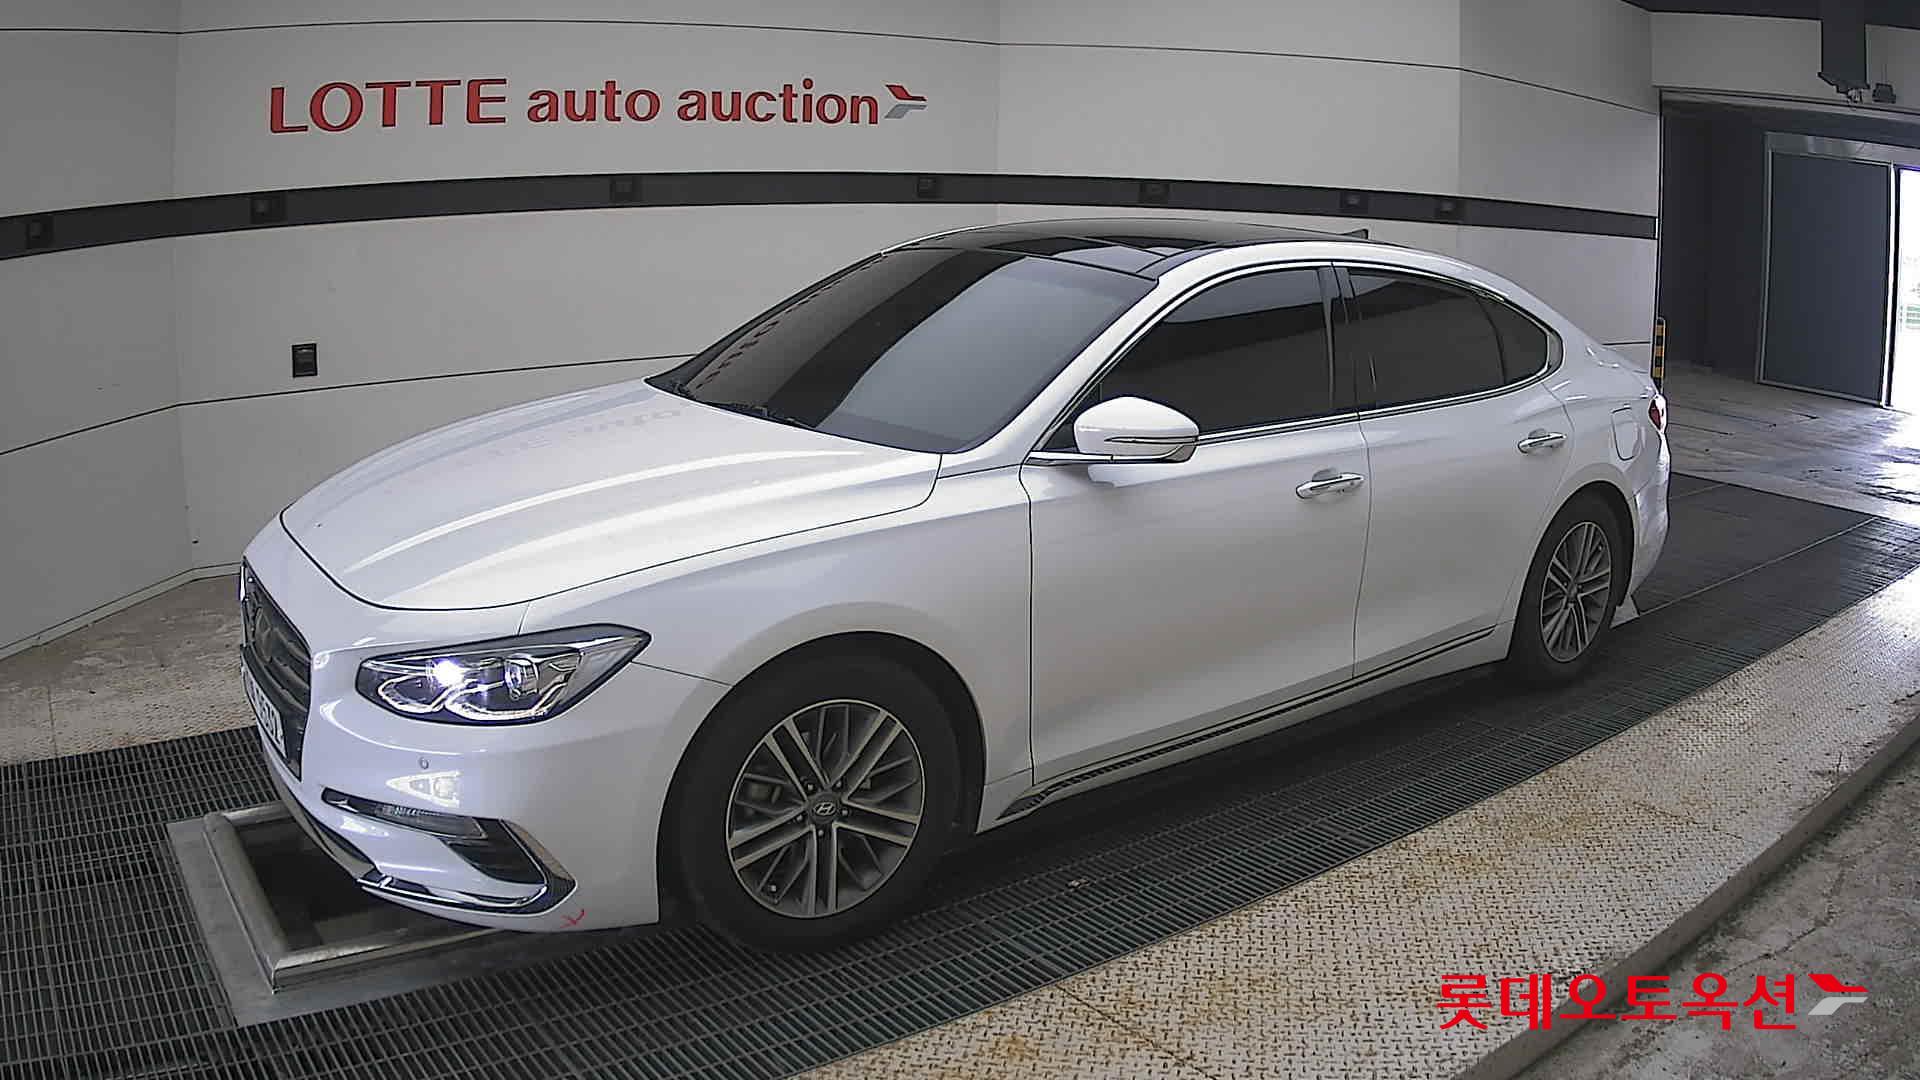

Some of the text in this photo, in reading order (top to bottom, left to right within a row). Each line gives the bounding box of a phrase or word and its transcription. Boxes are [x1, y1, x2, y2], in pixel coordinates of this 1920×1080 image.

[271, 78, 880, 133] LOTTE auto auction
